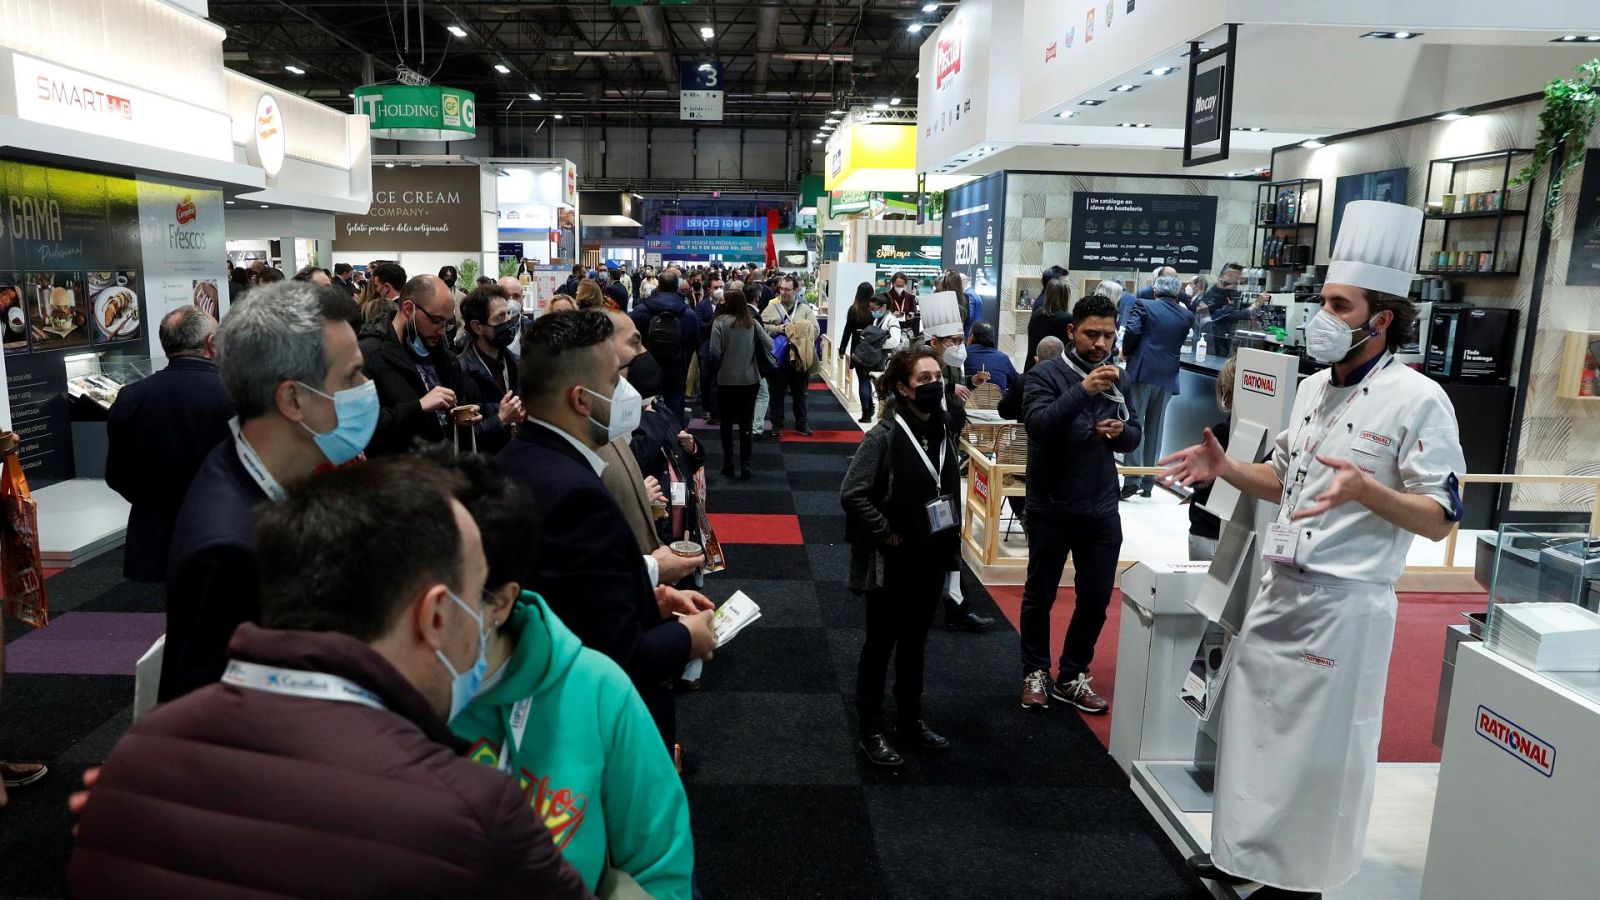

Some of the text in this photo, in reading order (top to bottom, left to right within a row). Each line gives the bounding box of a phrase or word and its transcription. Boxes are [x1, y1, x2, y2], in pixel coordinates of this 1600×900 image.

[705, 67, 718, 87] 3
[378, 104, 438, 117] HOLDING
[1194, 95, 1217, 114] Mocay
[403, 191, 460, 204] CREAM
[8, 195, 62, 241] GAMA
[370, 207, 424, 217] COMPANY
[168, 224, 207, 250] Frescos
[1243, 371, 1275, 392] RATIONAL
[1361, 432, 1390, 446] RATIONAL
[1305, 655, 1334, 667] RATIONAL
[1479, 711, 1551, 770] RATIONAL
